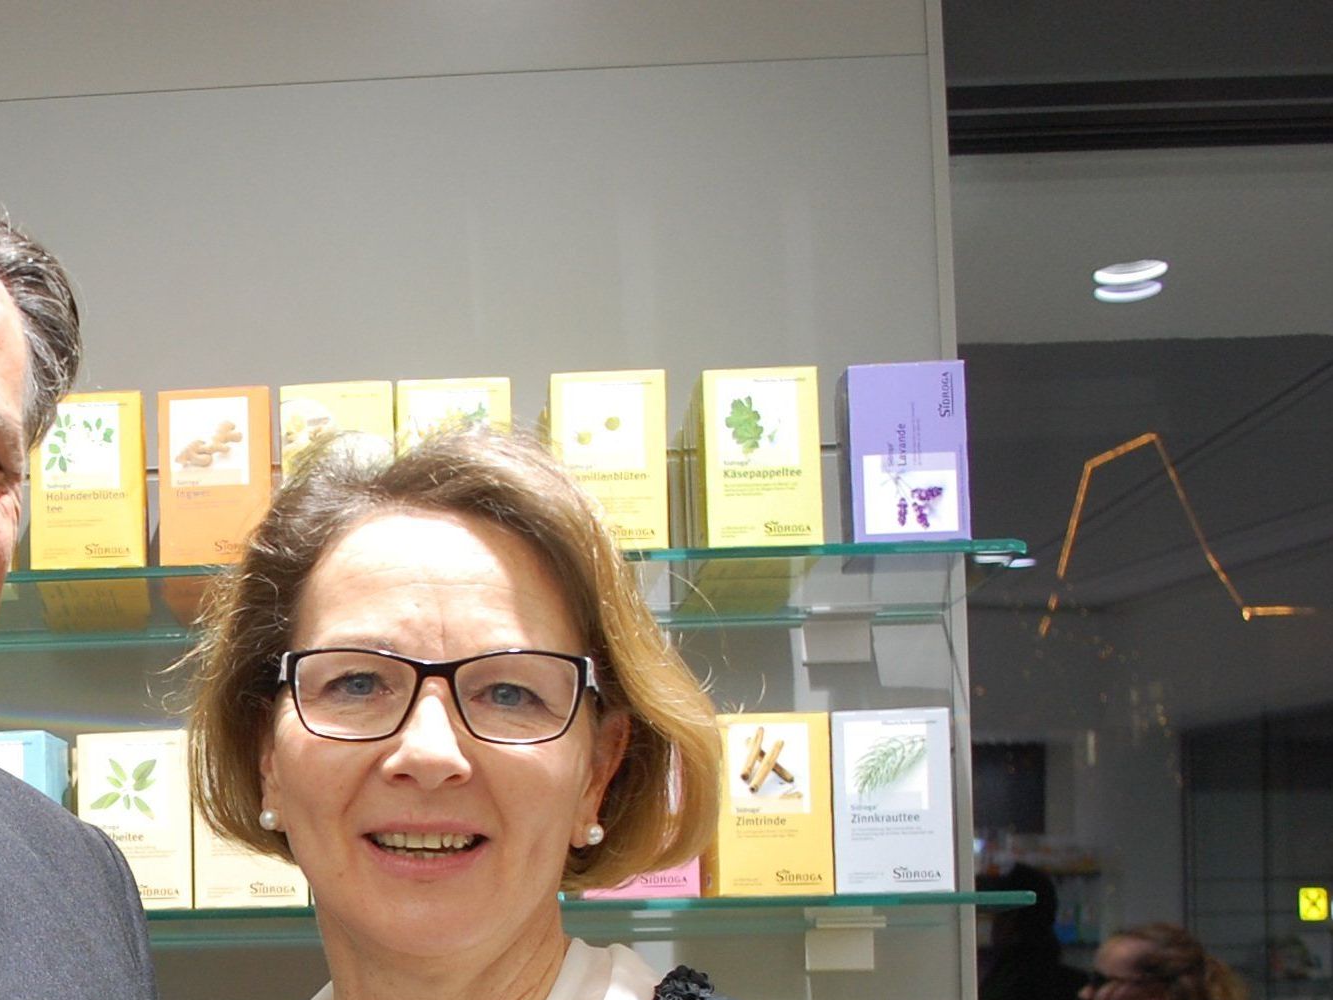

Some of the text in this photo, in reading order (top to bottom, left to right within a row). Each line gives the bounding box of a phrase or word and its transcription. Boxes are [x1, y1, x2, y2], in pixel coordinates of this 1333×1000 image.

[939, 371, 951, 418] SIDROGA
[896, 423, 907, 467] Lavande
[575, 470, 650, 482] amillenblüten-
[723, 466, 803, 480] Käsepappeltee
[46, 502, 63, 514] tee
[764, 521, 811, 535] SIDROGA
[735, 816, 787, 827] Zimtrinde
[850, 812, 921, 825] Zinnkrauttee
[640, 874, 688, 884] SIDROGA
[775, 870, 823, 882] SIDROGA
[892, 867, 942, 880] SIDROGA
[139, 886, 180, 897] IDROGA
[249, 881, 296, 894] SIDROGA
